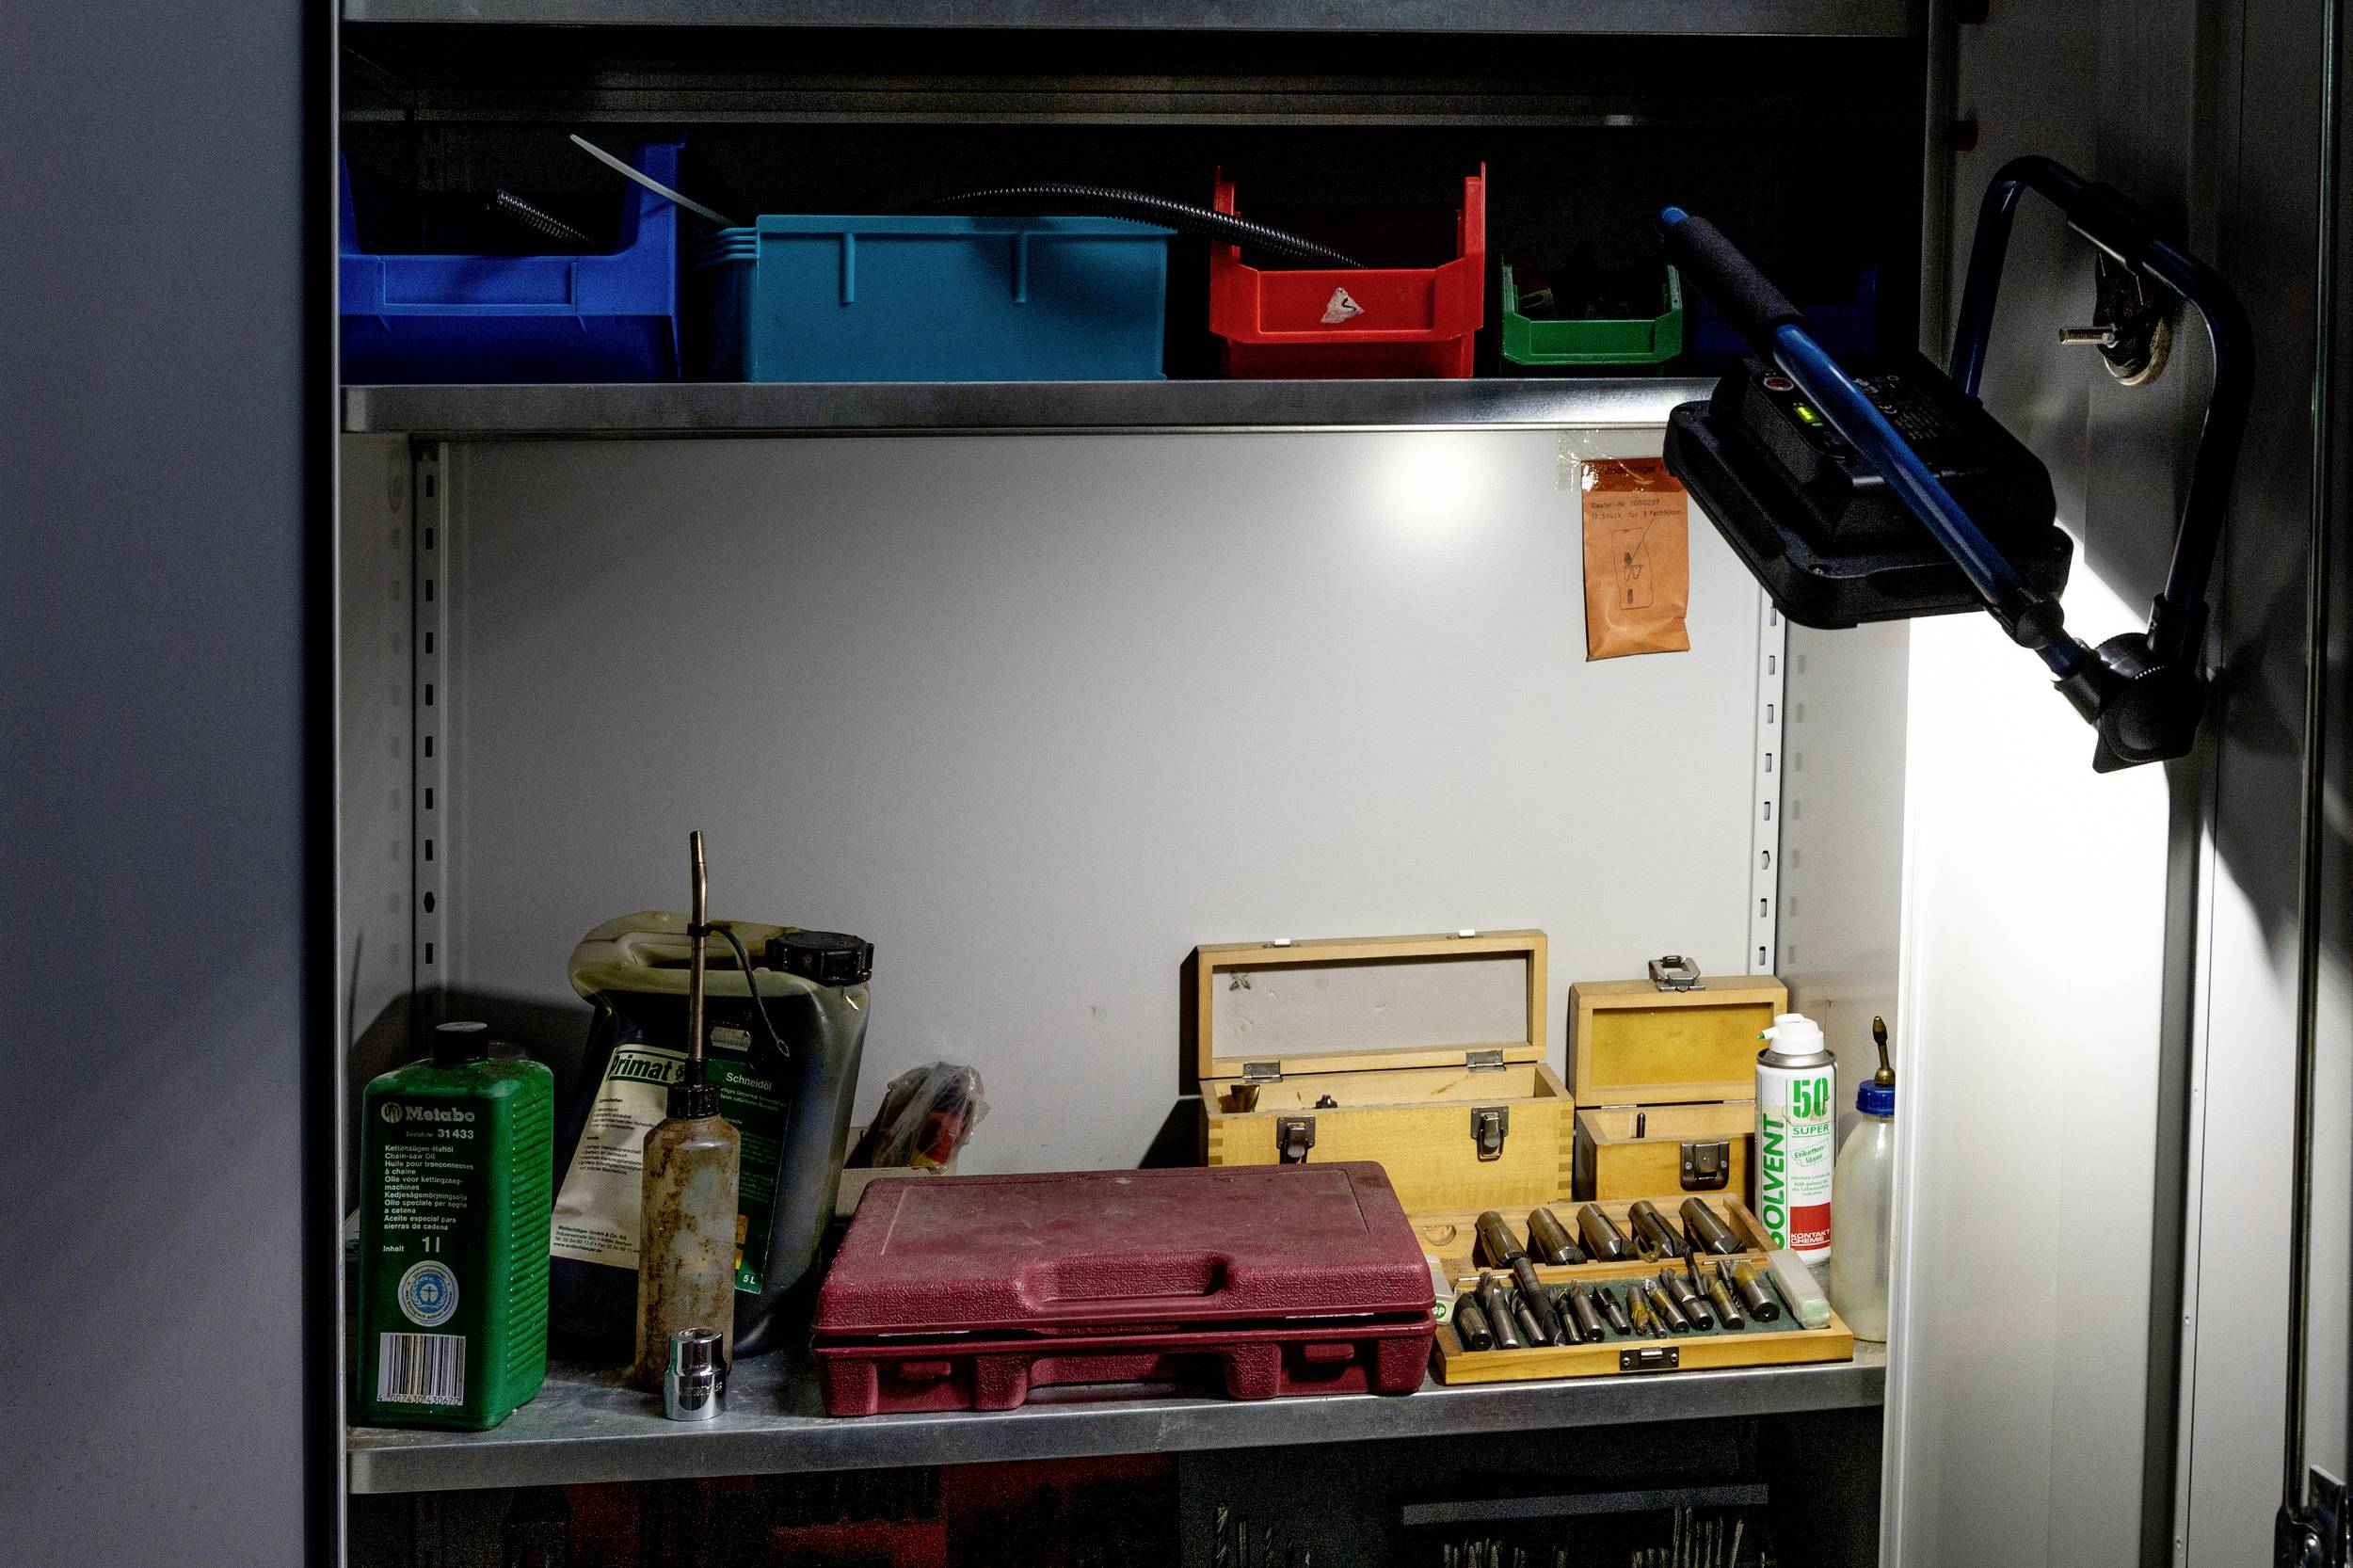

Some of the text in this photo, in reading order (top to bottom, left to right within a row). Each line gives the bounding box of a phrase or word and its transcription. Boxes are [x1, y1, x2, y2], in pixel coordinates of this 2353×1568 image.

[726, 1072, 772, 1091] Schneidöl
[1793, 1078, 1829, 1118] 50
[405, 1105, 475, 1122] Metabo
[1793, 1124, 1829, 1135] SUPER
[384, 1144, 454, 1153] Kettensägen-Haftöl
[1805, 1153, 1823, 1164] löser
[1791, 1229, 1831, 1238] KONTAKT
[1791, 1236, 1825, 1244] CHEMIE
[743, 1274, 756, 1284] 5 L
